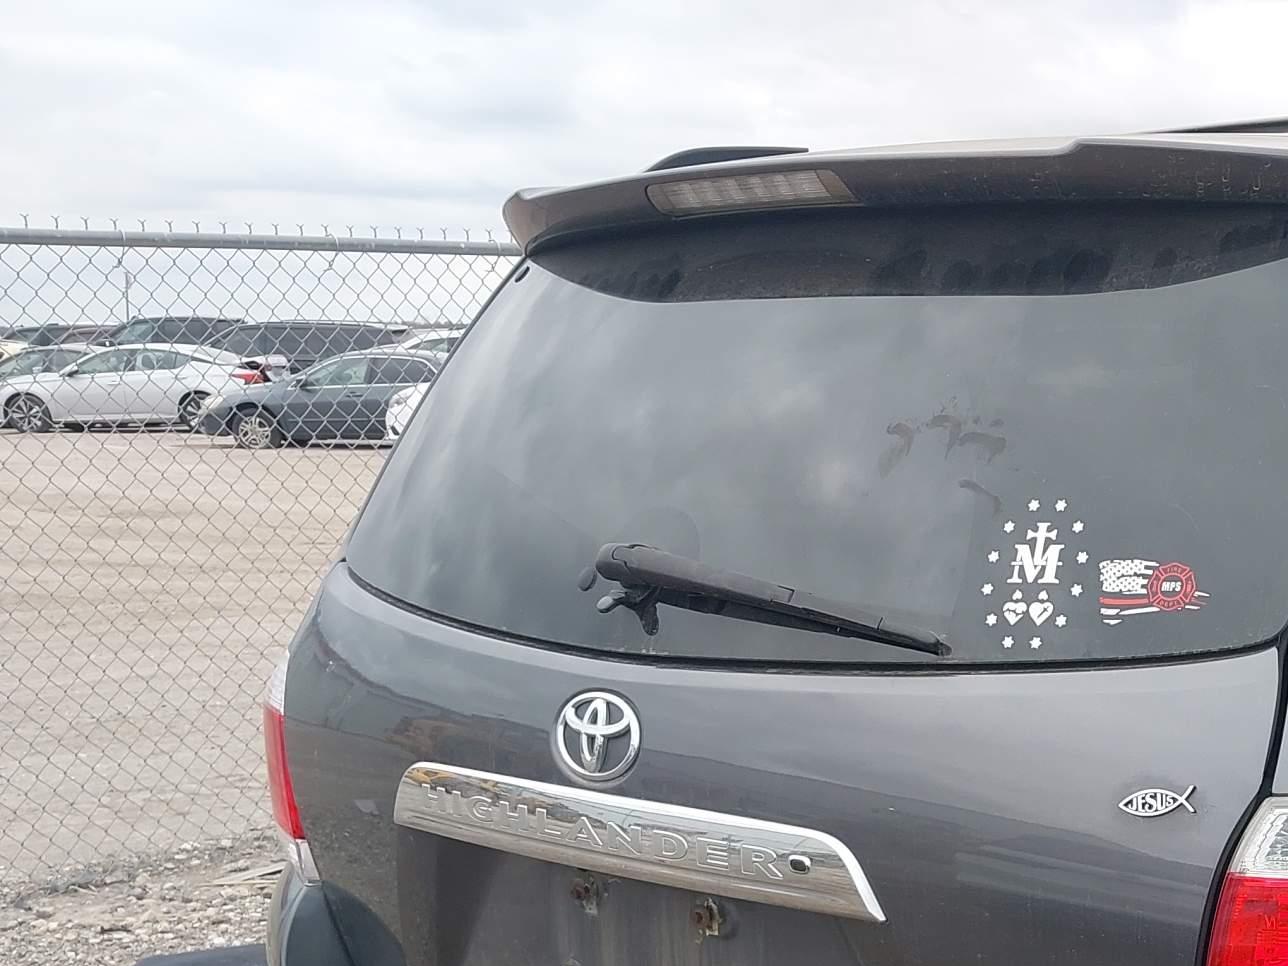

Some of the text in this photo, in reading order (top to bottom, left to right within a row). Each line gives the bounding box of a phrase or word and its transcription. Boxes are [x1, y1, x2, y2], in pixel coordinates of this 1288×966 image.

[1161, 580, 1183, 592] MPS
[1127, 792, 1175, 813] JESUS
[420, 783, 785, 881] HIGHLANDER
